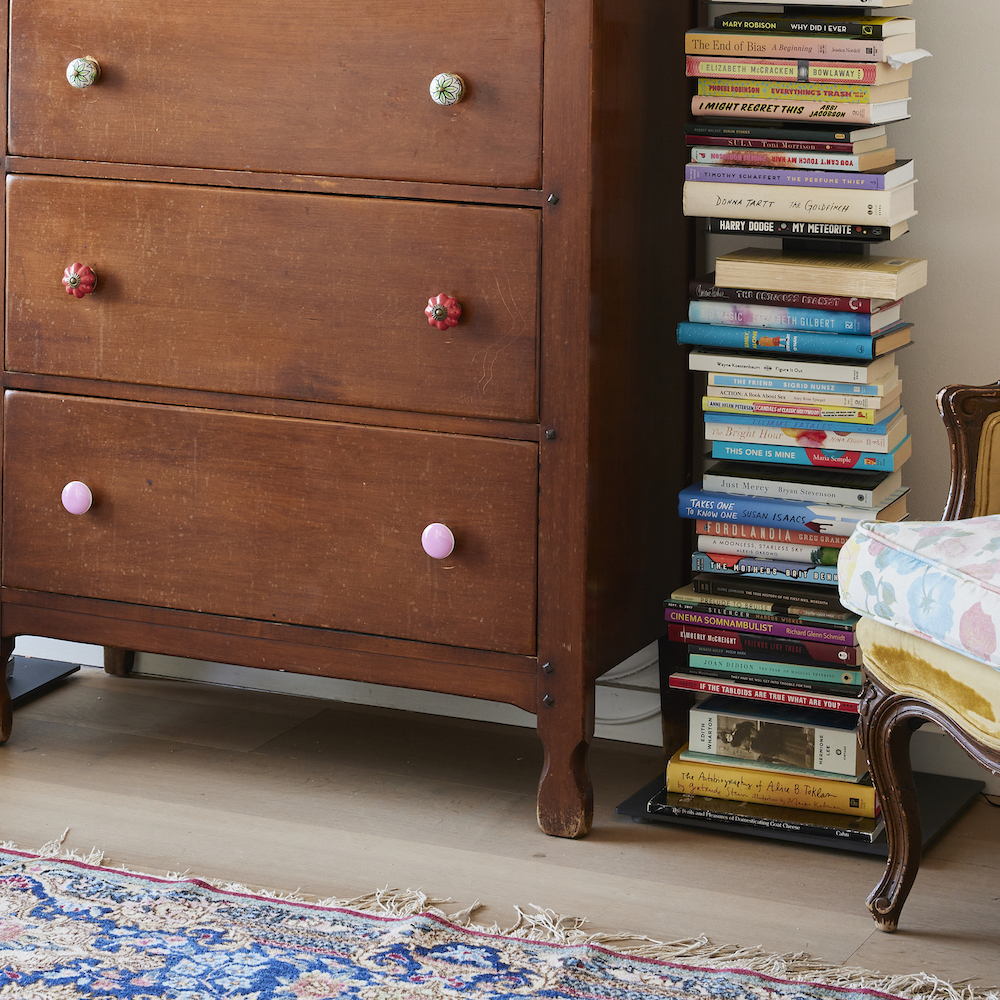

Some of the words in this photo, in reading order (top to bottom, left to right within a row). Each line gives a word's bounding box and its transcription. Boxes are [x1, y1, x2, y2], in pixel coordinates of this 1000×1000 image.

[692, 39, 710, 49] The
[713, 40, 731, 51] End
[734, 41, 744, 51] of
[747, 41, 766, 51] Bias
[779, 44, 813, 53] Beginning
[706, 64, 747, 73] ELIZABETH
[751, 66, 794, 75] McCRACKEN
[813, 69, 855, 77] BOWLAWAY
[705, 102, 739, 111] MIGHT
[741, 103, 780, 112] REGRET
[781, 105, 805, 114] THIS
[720, 220, 747, 231] HARRY
[749, 222, 774, 232] DODGE
[792, 223, 805, 233] MY
[808, 224, 851, 235] METEORITE
[725, 447, 743, 456] THIS
[745, 448, 763, 457] ONE
[765, 449, 772, 457] IS
[774, 450, 795, 459] MINE
[721, 480, 740, 489] Just
[742, 482, 769, 493] Mercy
[670, 612, 703, 624] CINEMA
[704, 616, 773, 632] SOMNAMBULIST
[786, 628, 805, 637] Richard
[806, 630, 822, 639] Glenn
[823, 632, 846, 641] Schmidt
[708, 684, 720, 692] THE
[722, 685, 752, 697] TABLOIDS
[754, 689, 767, 699] ARE
[769, 691, 786, 701] TRUE
[788, 694, 806, 704] WHAT
[809, 696, 821, 706] ARE
[824, 698, 841, 709] YOU?
